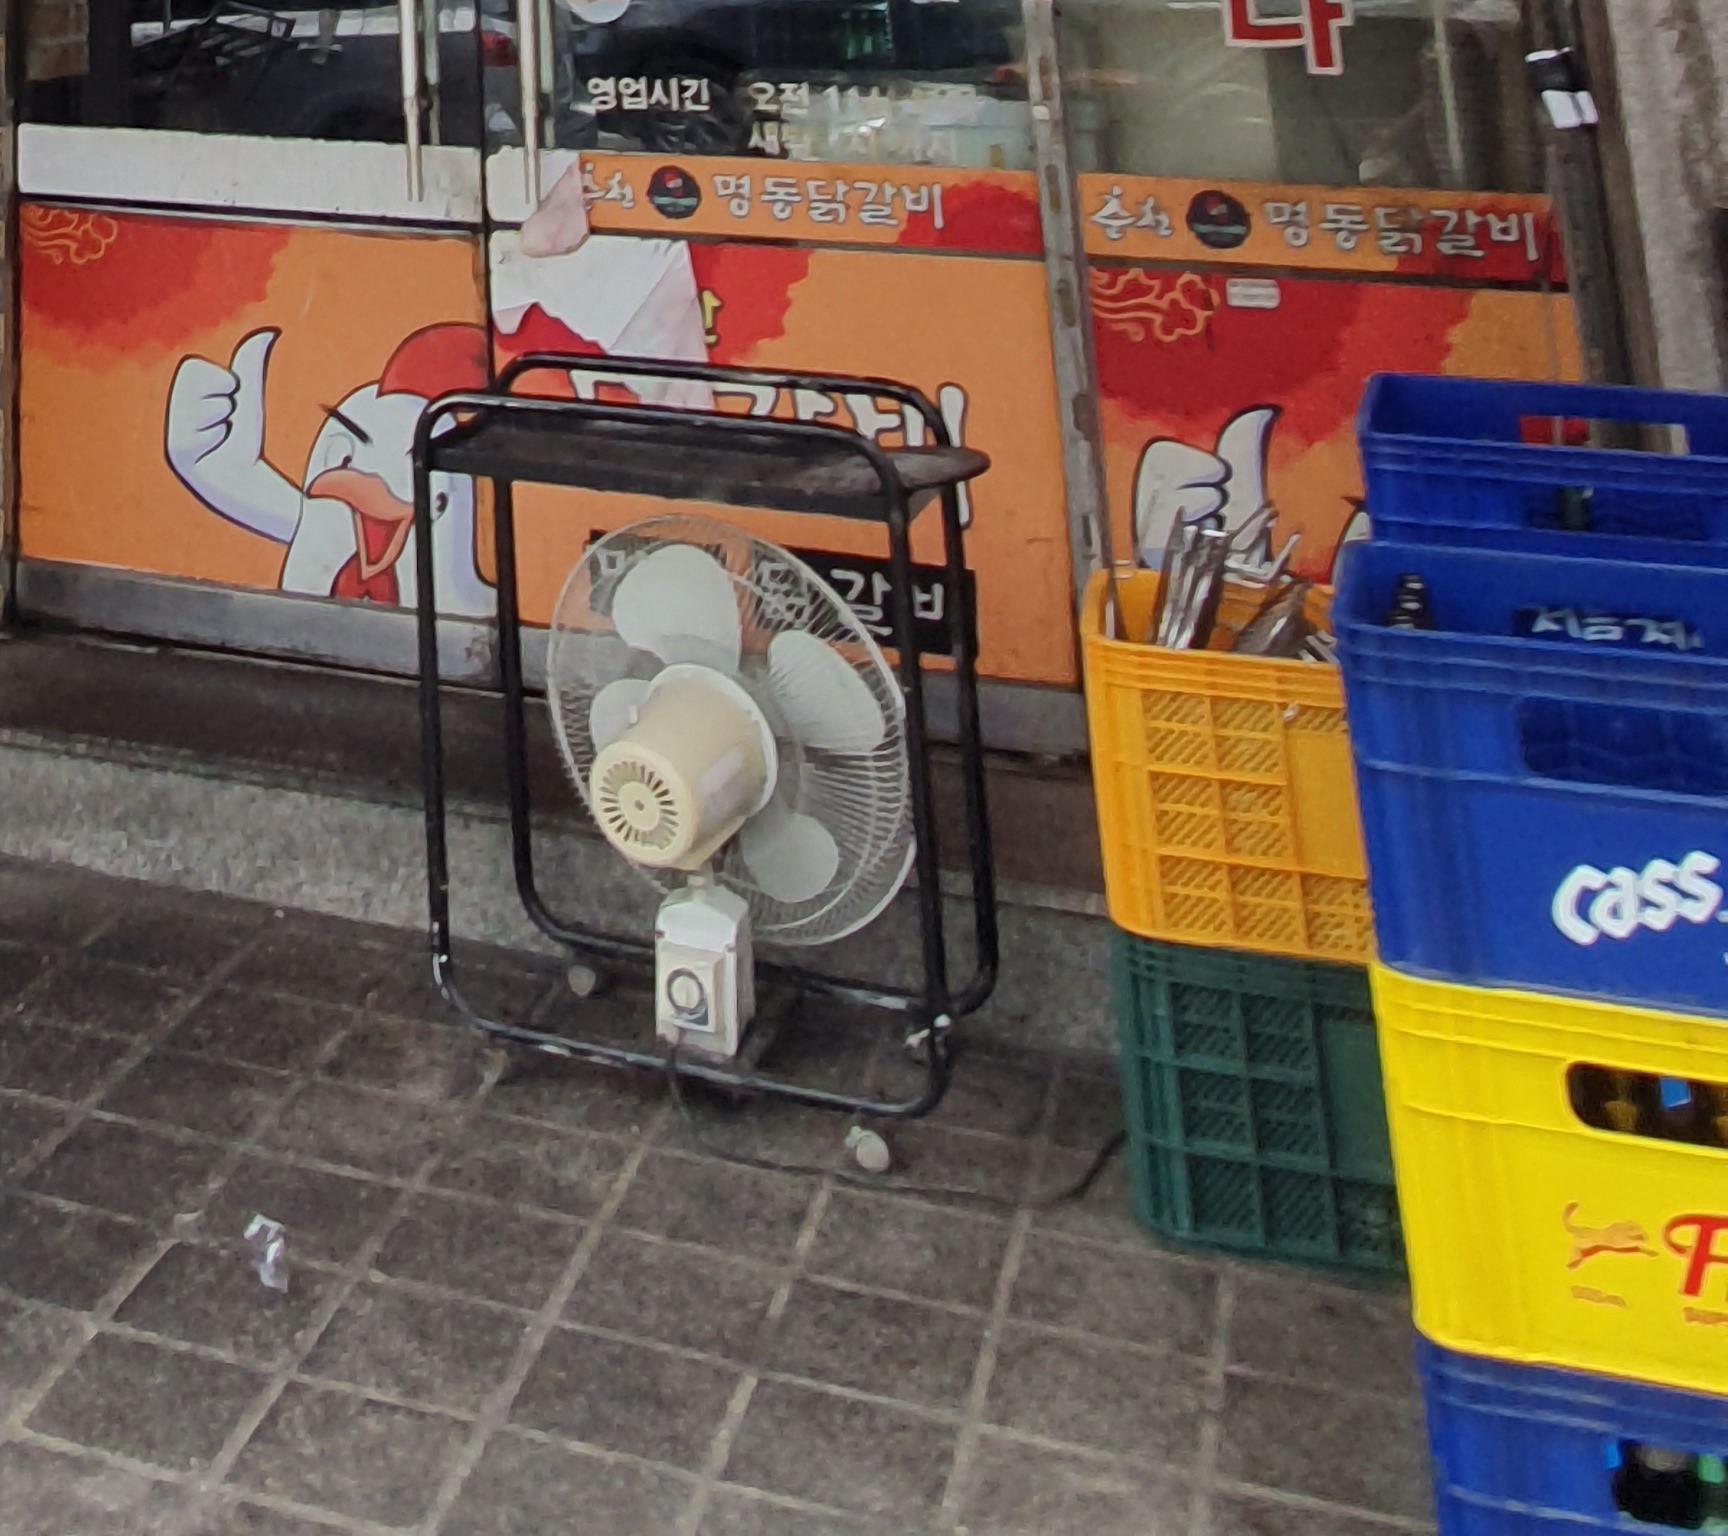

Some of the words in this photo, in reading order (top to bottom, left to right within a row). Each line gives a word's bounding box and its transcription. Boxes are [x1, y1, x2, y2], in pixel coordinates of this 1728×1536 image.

[587, 76, 710, 112] 영업시간
[748, 80, 810, 115] 오전
[1090, 185, 1174, 240] 춘천
